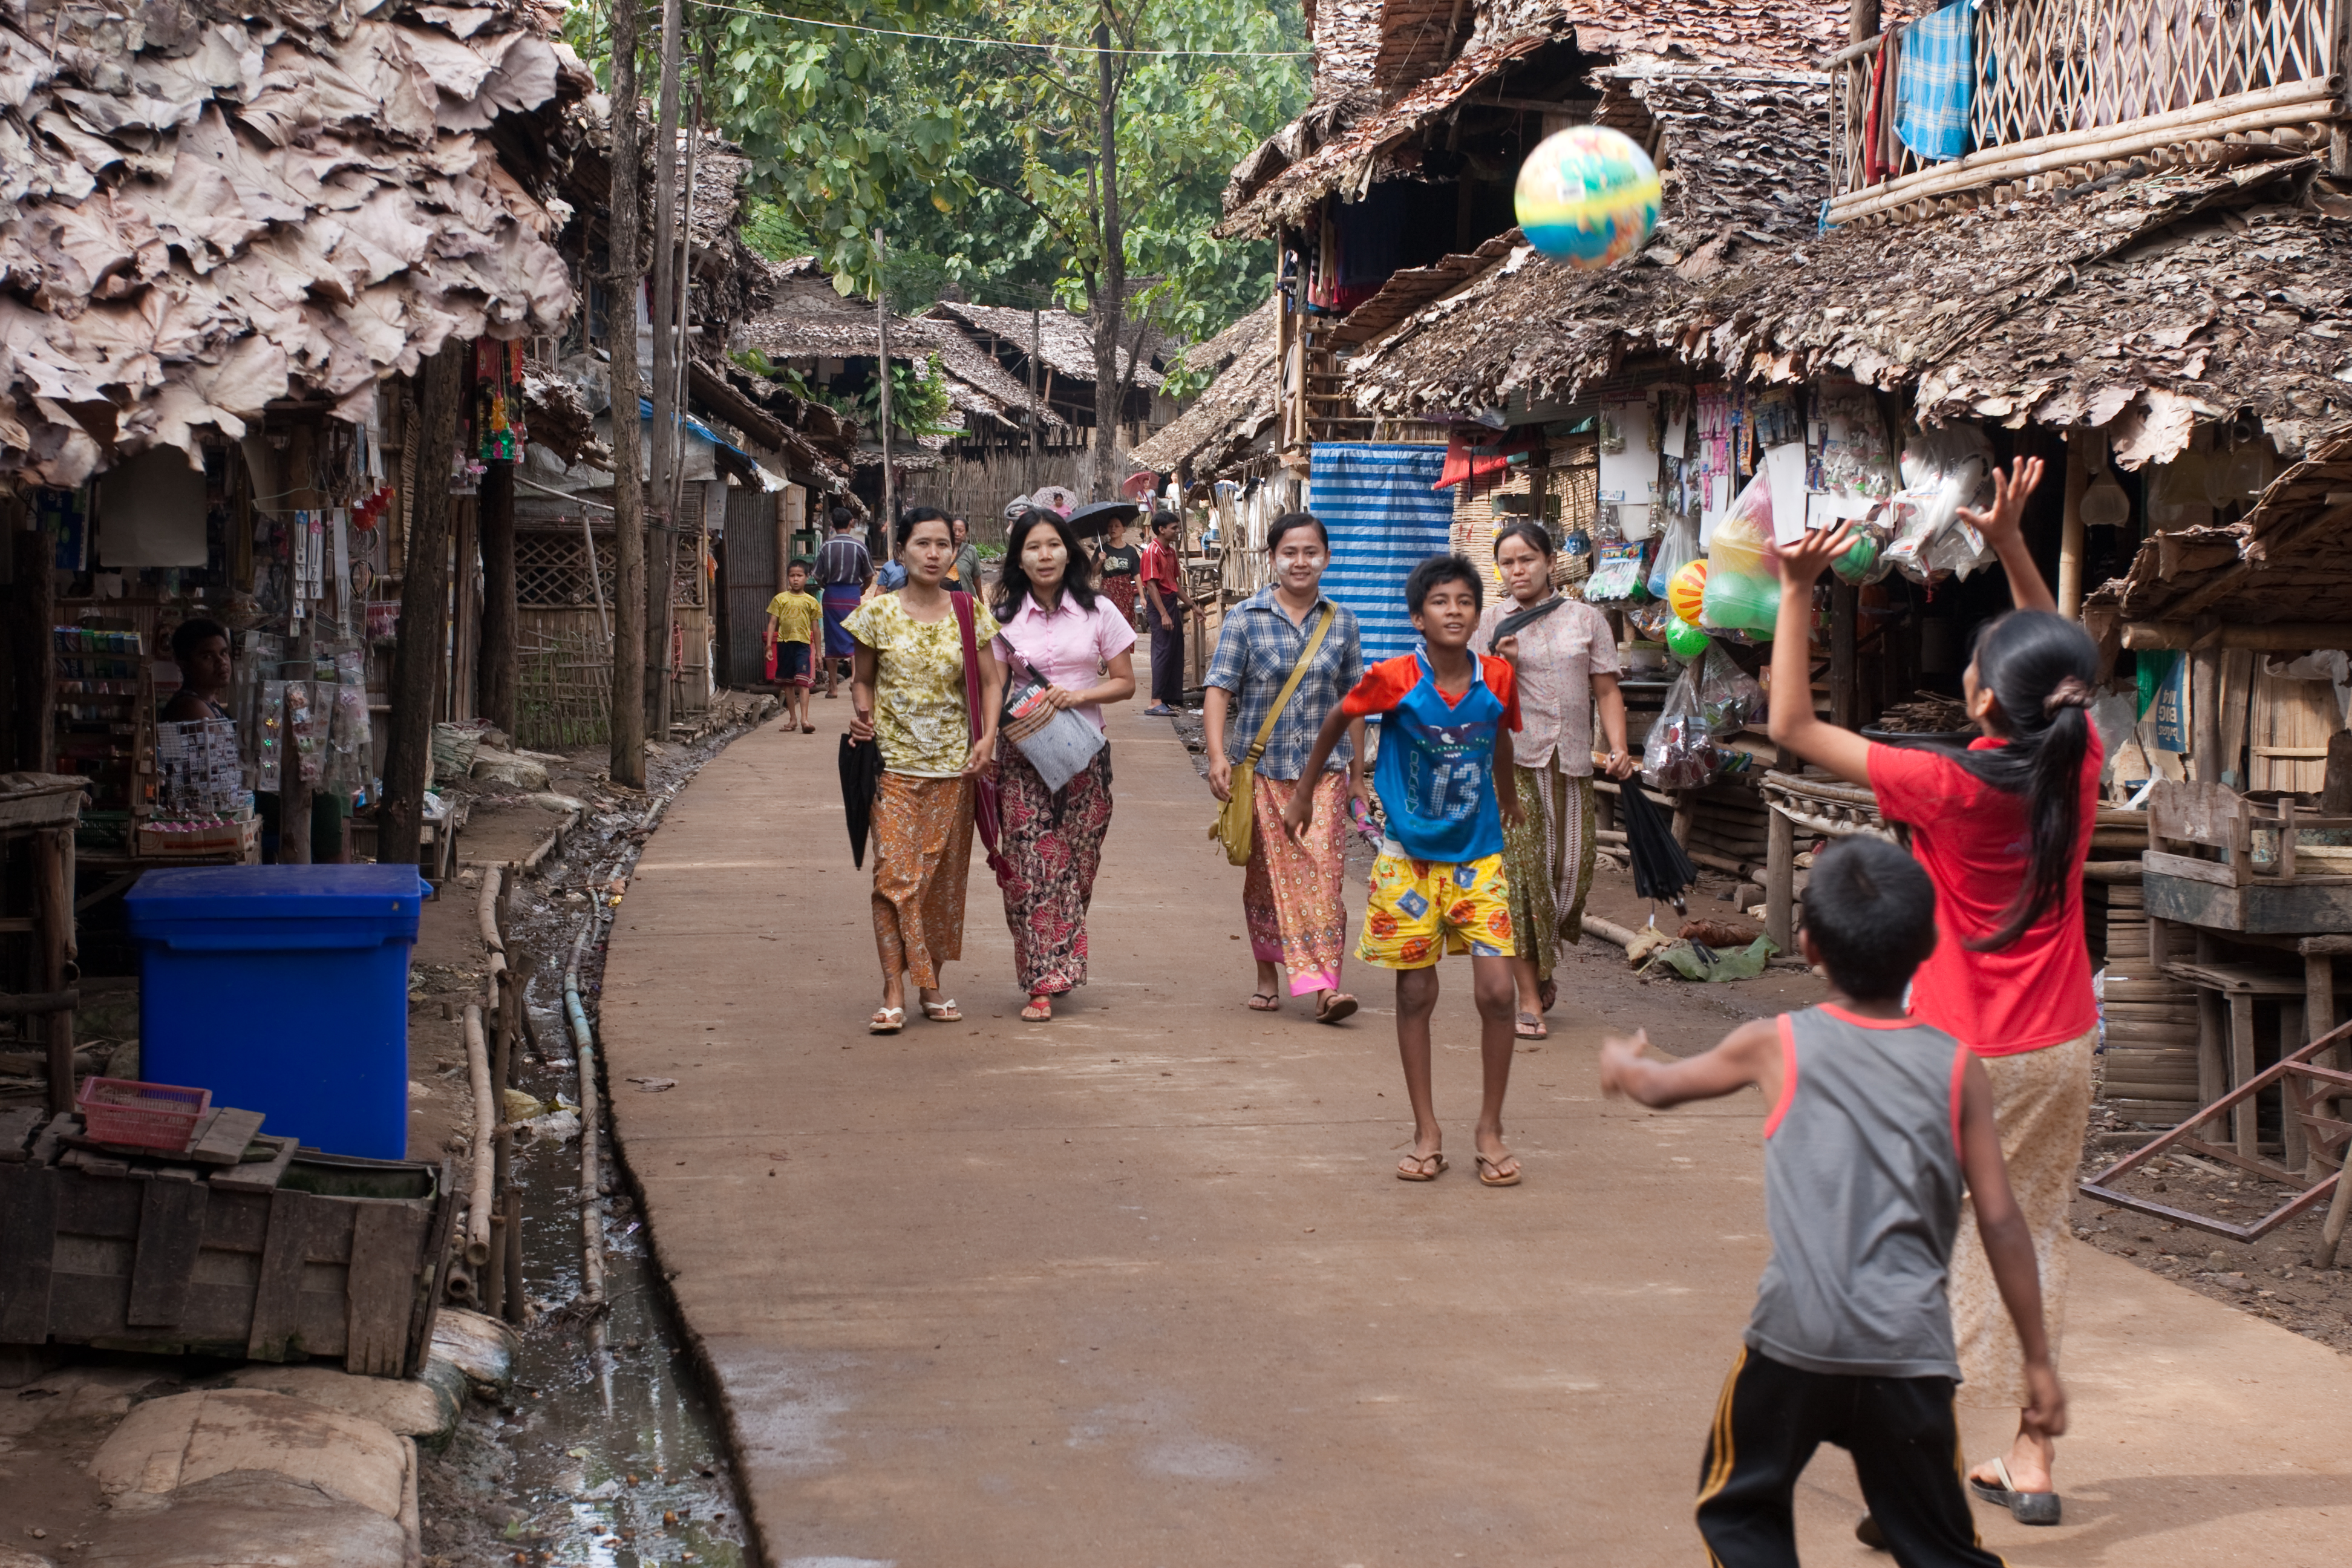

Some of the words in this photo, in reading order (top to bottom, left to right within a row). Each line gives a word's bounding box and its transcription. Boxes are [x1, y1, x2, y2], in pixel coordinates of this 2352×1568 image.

[1027, 684, 1042, 697] On
[2163, 690, 2177, 705] M4
[2158, 707, 2177, 723] BIG
[1428, 762, 1481, 819] 13
